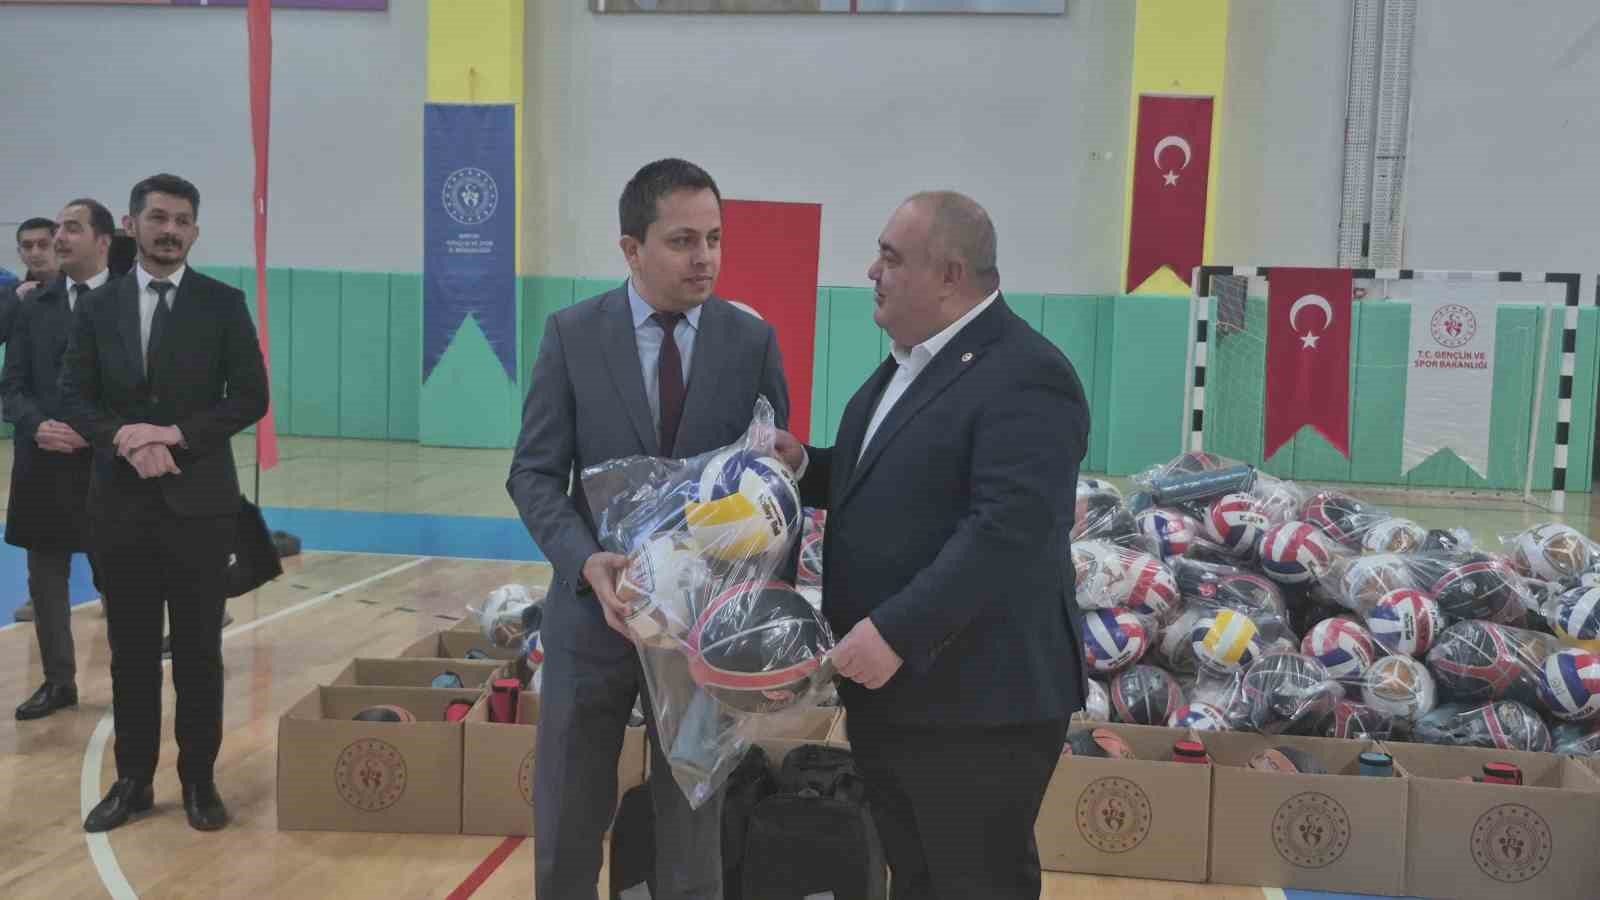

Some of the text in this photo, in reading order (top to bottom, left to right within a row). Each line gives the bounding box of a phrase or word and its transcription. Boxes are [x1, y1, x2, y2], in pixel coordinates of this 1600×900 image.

[1474, 352, 1485, 360] VE
[1415, 360, 1488, 369] SPOR BAKANLIĞI
